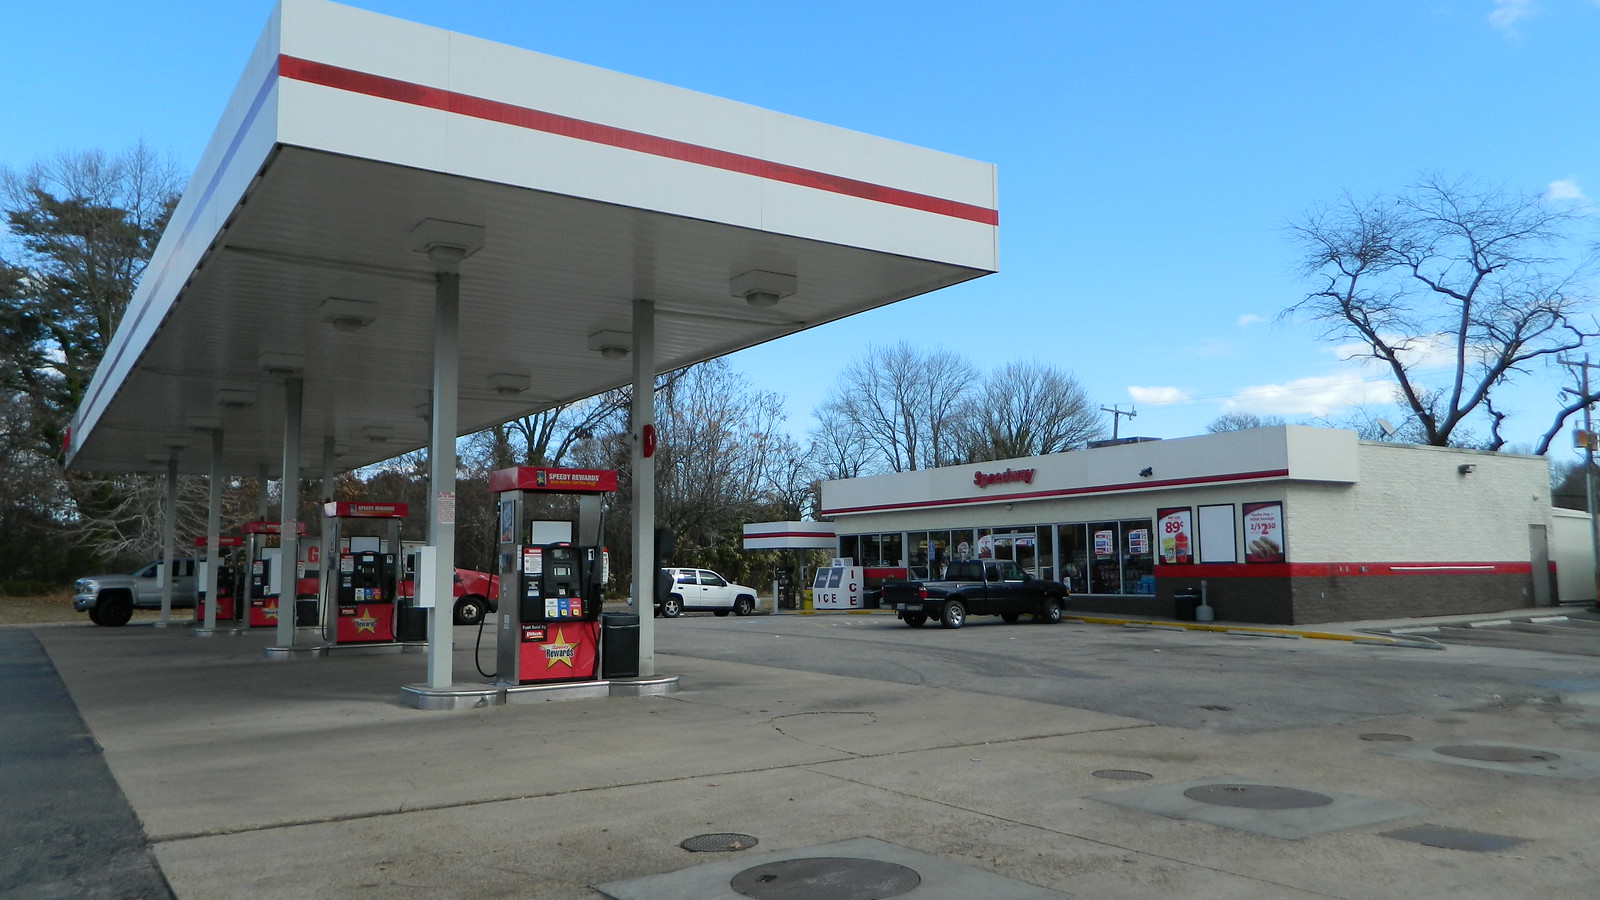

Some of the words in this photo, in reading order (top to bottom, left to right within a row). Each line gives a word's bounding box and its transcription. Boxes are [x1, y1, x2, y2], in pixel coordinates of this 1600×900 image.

[549, 473, 571, 481] SPEEDY
[572, 474, 599, 482] REWARDS
[973, 468, 1035, 488] Speedway
[589, 549, 594, 560] 1
[849, 569, 858, 605] ICE
[818, 593, 837, 603] ICE
[546, 649, 574, 658] Rewards
